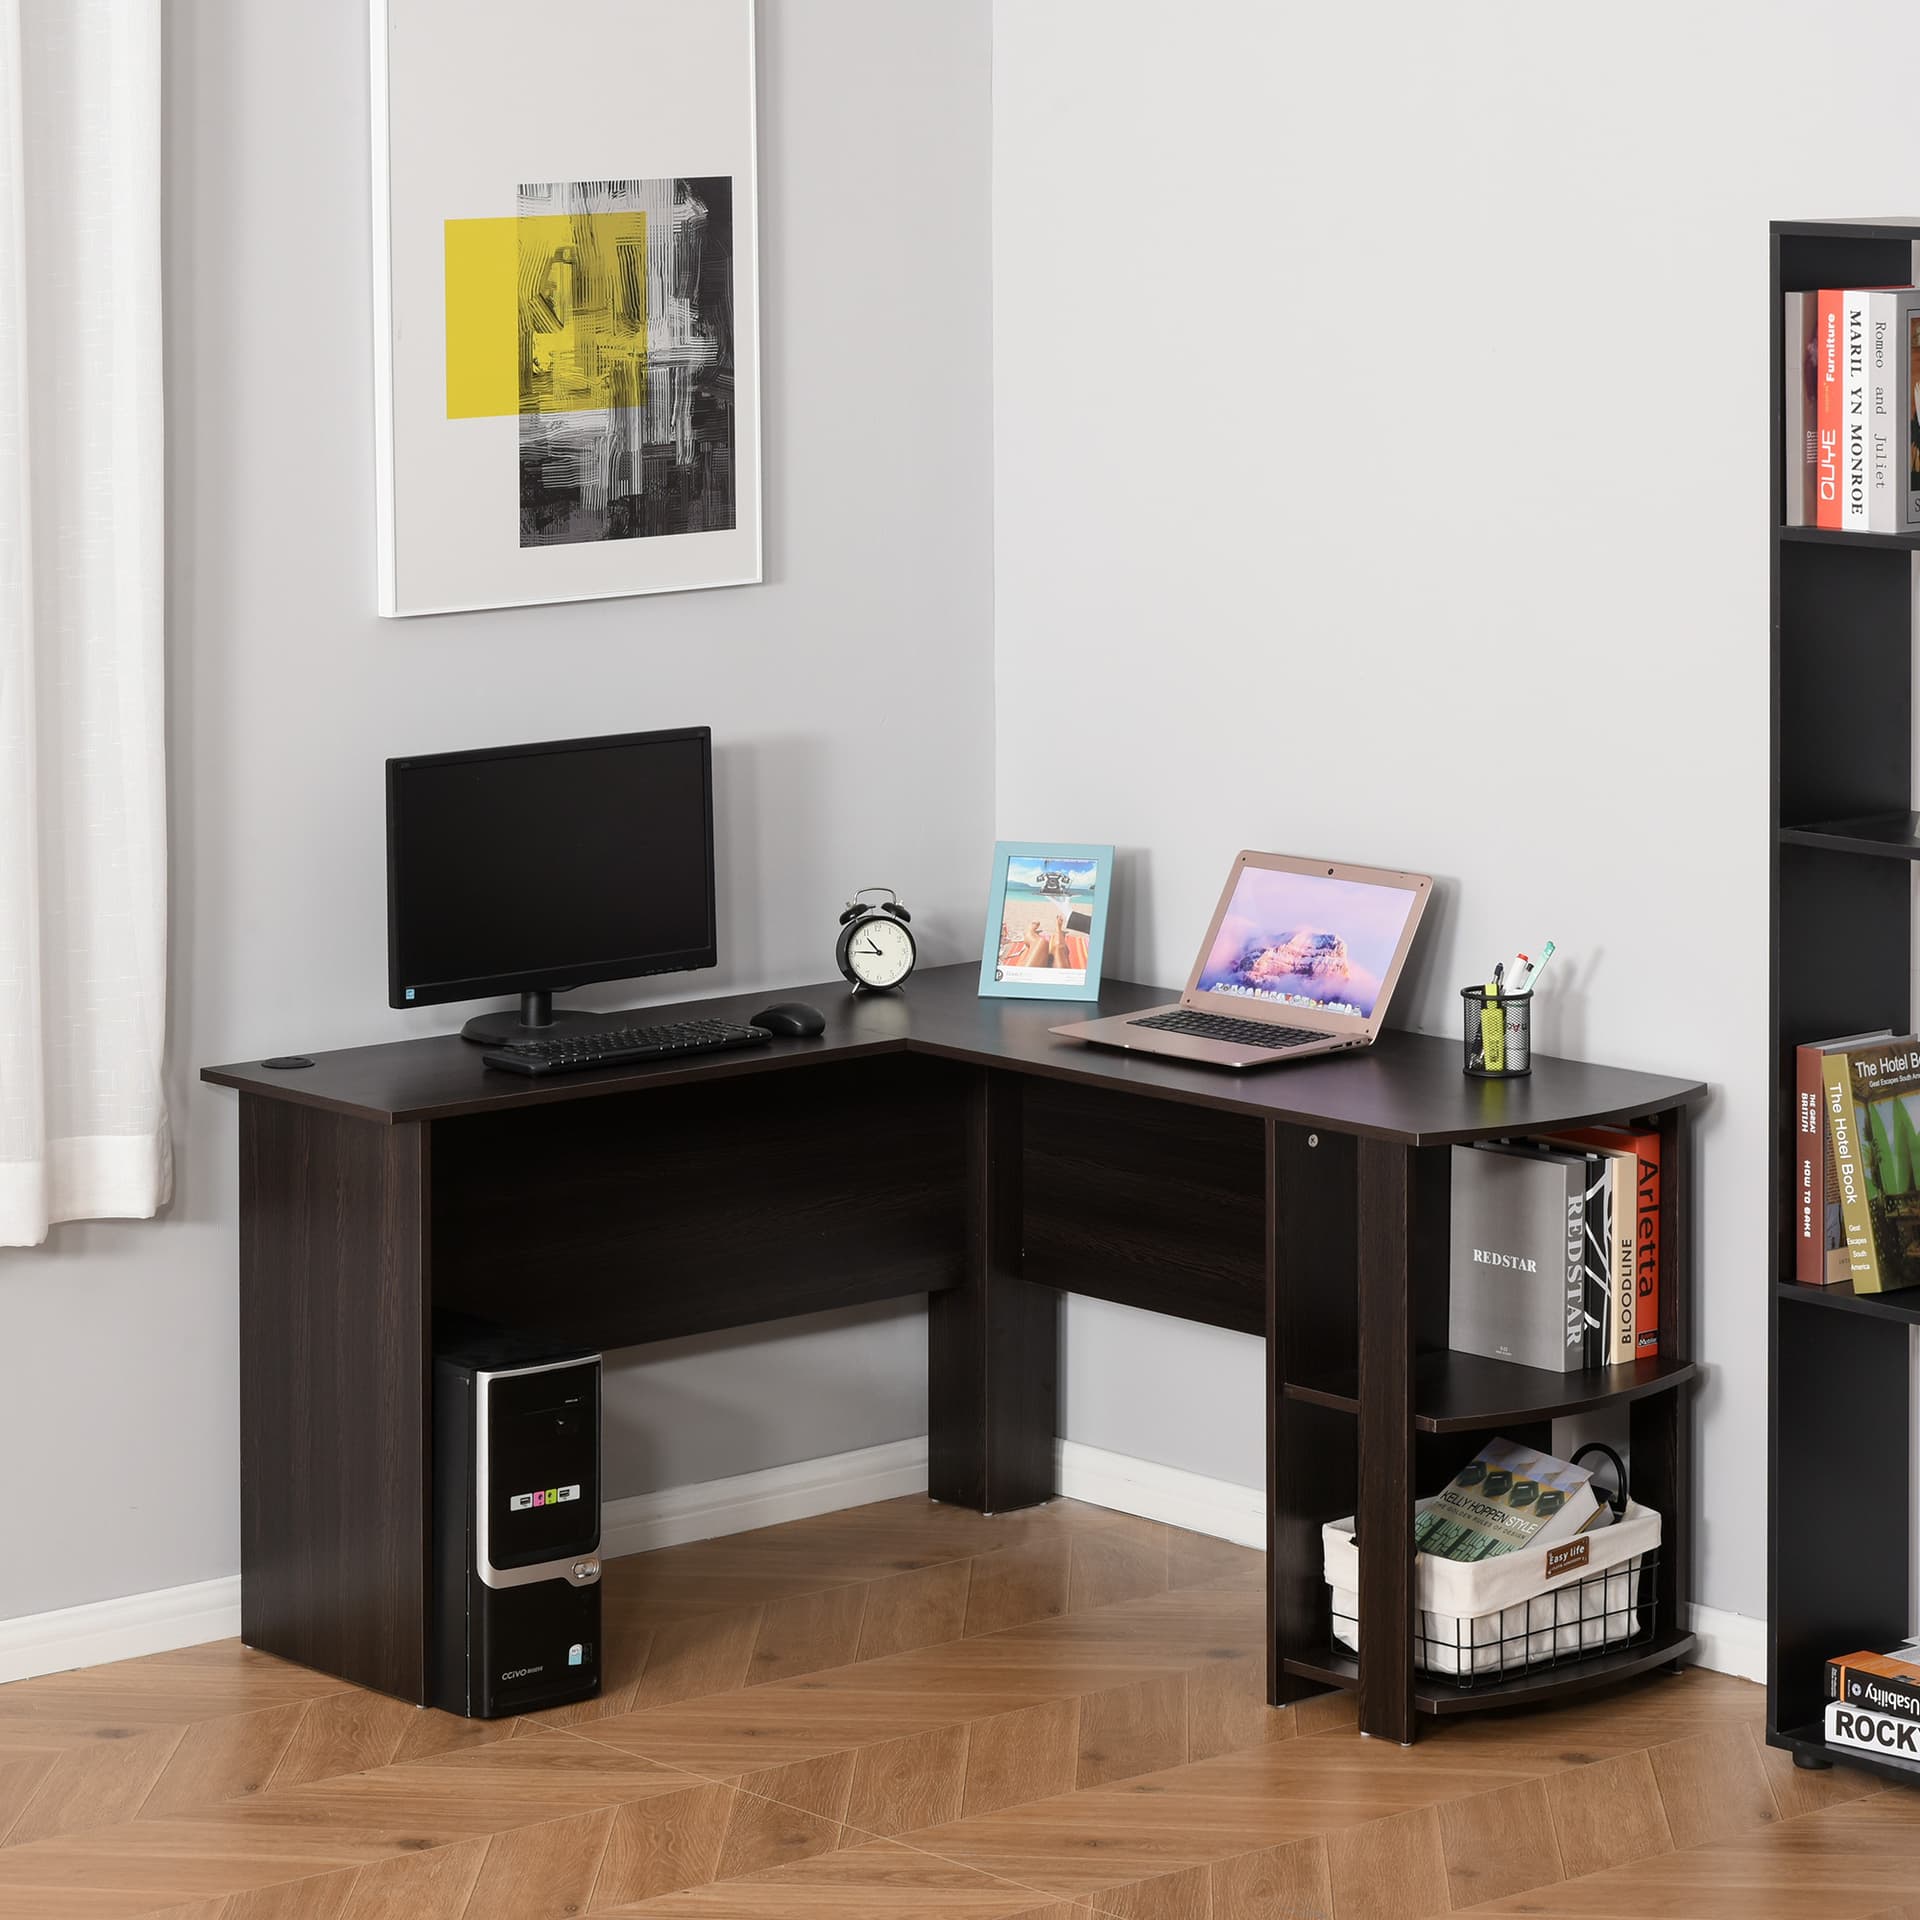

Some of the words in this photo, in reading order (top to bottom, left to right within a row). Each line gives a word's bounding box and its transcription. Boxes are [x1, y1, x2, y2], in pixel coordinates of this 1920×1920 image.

[1825, 312, 1836, 383] Furniture
[1875, 321, 1887, 369] Romeo
[1875, 386, 1887, 415] and
[1850, 423, 1863, 515] MONROE
[1874, 433, 1887, 489] Juliet
[1855, 1061, 1877, 1078] The
[1880, 1053, 1908, 1074] Hotel
[1829, 1082, 1842, 1113] The
[1834, 1118, 1852, 1159] Hotel
[1803, 1160, 1811, 1187] HOW
[1841, 1163, 1858, 1204] Book
[1803, 1190, 1811, 1204] TO
[1638, 1158, 1660, 1298] Arletta
[1473, 1248, 1537, 1273] REDSTAR
[1567, 1192, 1584, 1348] REDSTAR
[1621, 1239, 1633, 1344] BLOODLINE
[1440, 1490, 1469, 1507] KELLY
[1467, 1501, 1509, 1523] HOPPEN
[1505, 1516, 1539, 1534] STYLE
[1549, 1551, 1569, 1565] Easy
[1570, 1544, 1585, 1557] life
[1865, 1682, 1920, 1717] Usability
[1835, 1710, 1920, 1753] ROCK
